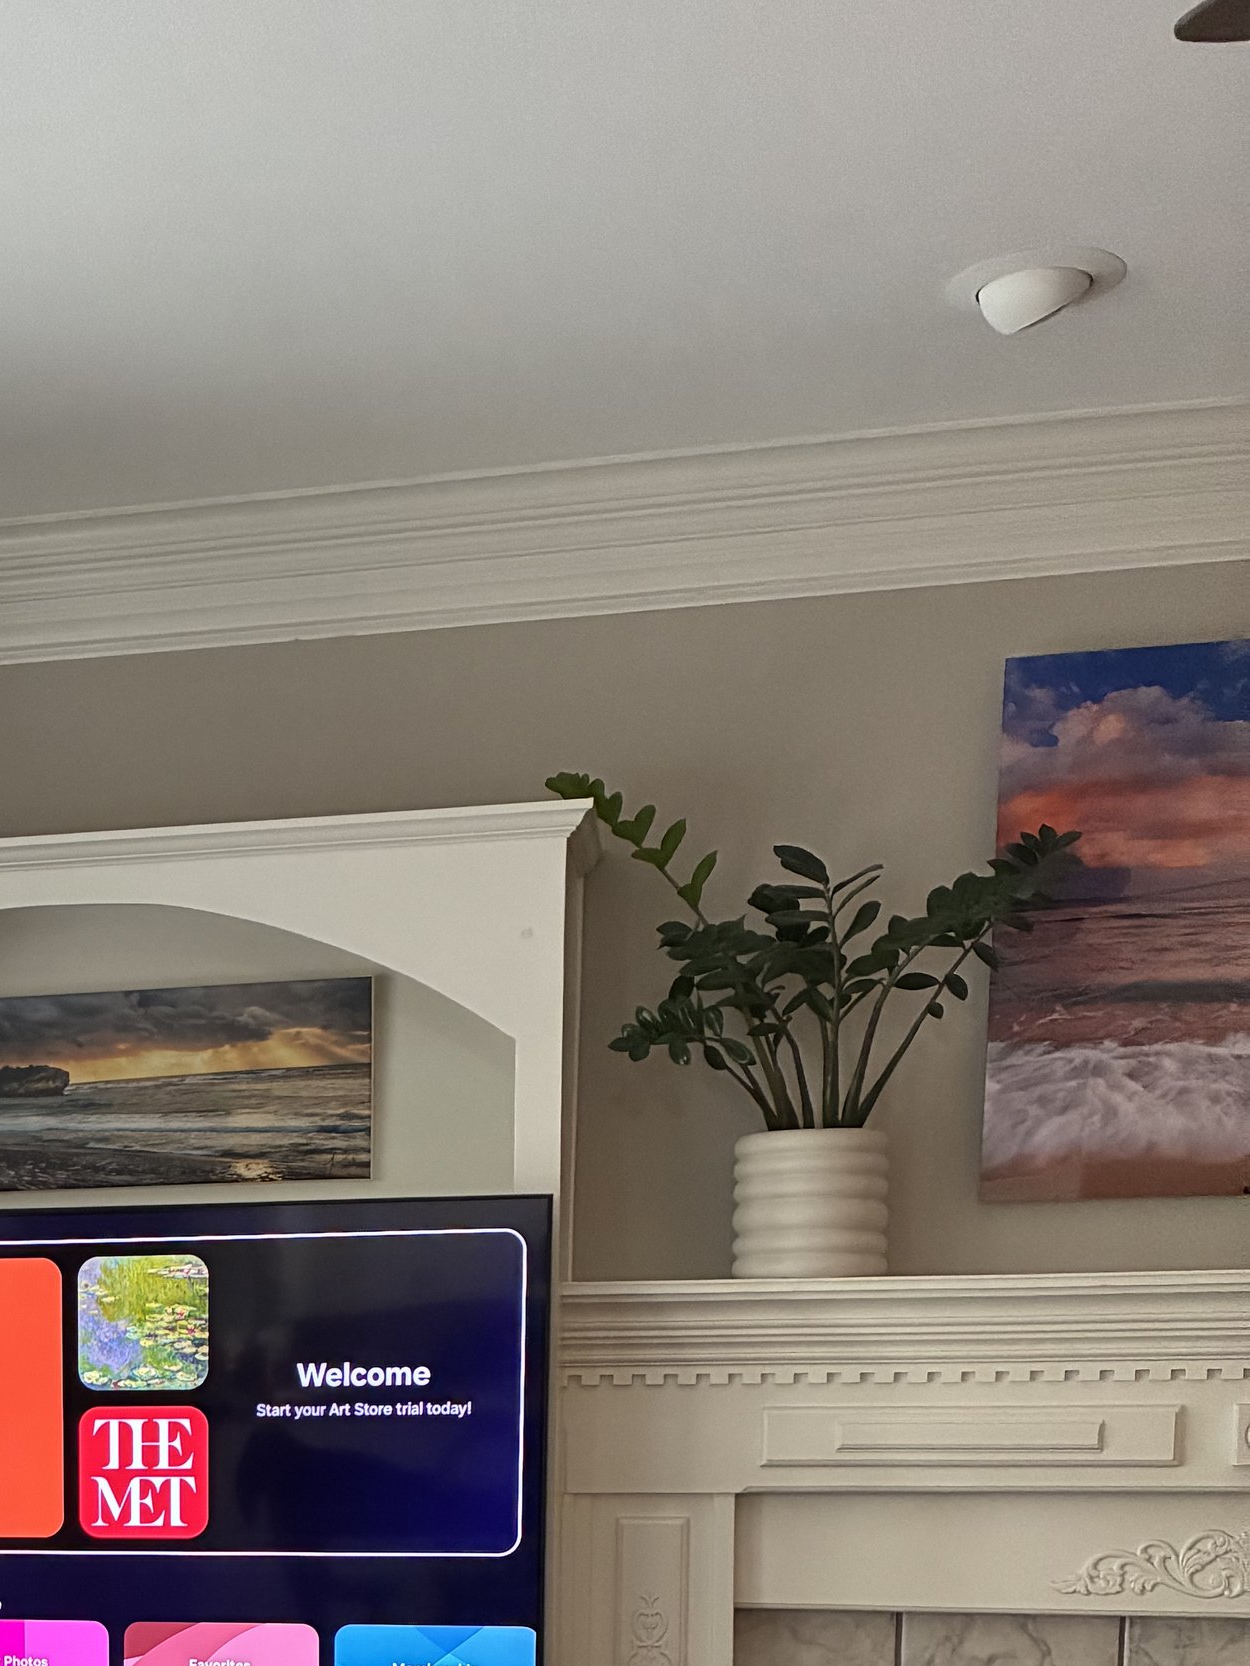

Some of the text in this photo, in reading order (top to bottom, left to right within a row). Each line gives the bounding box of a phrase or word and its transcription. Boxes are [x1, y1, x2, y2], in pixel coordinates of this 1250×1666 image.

[296, 1361, 432, 1388] Welcome
[256, 1400, 472, 1420] Start your Art Store trial today!
[92, 1418, 195, 1471] THE
[90, 1475, 197, 1528] MET
